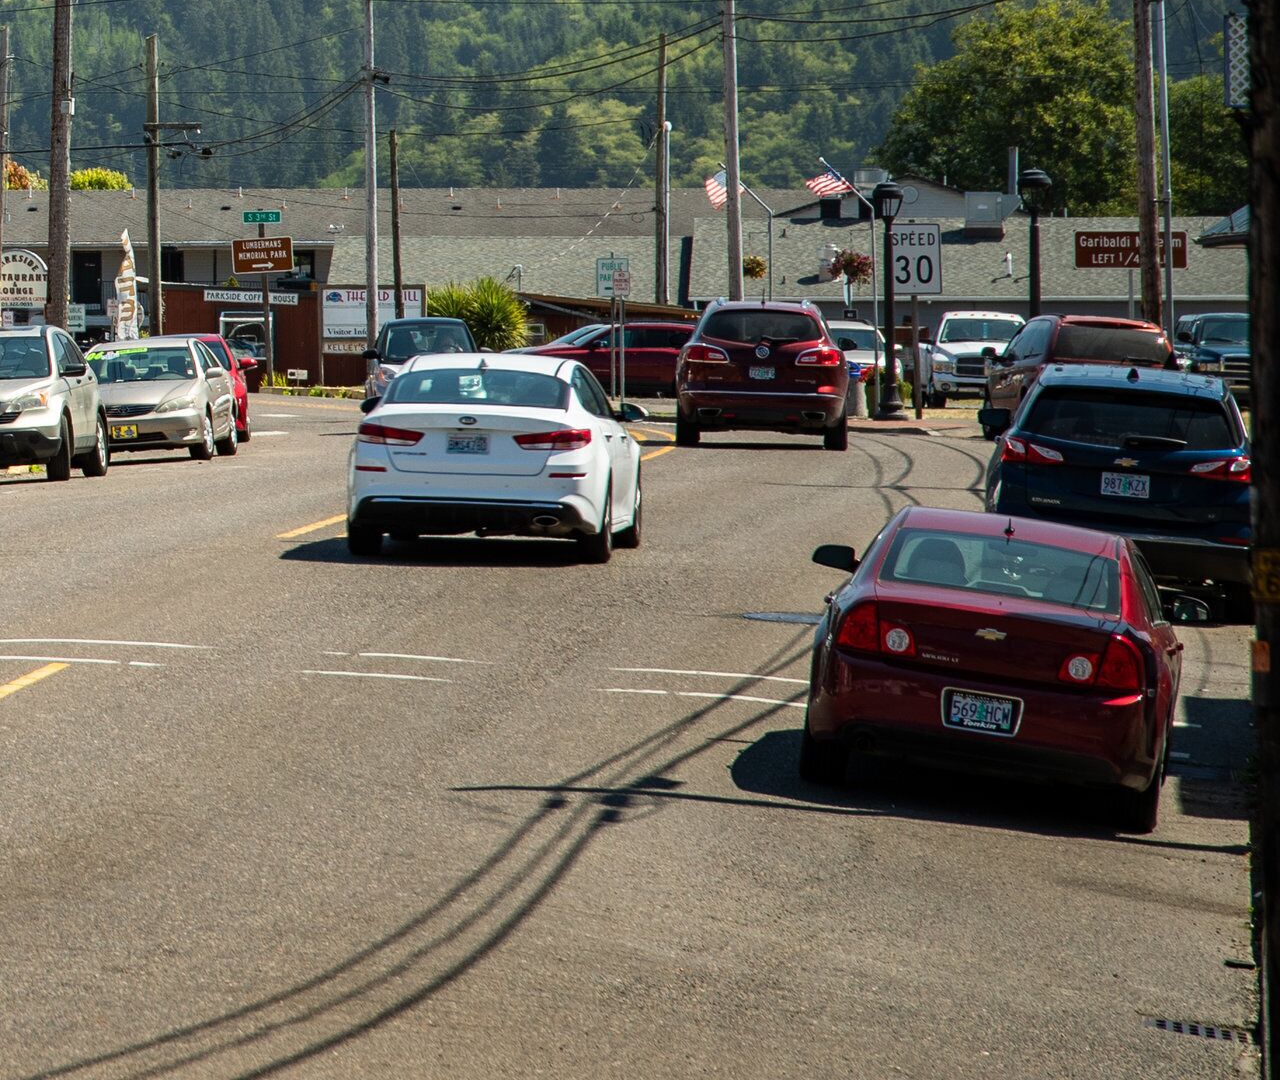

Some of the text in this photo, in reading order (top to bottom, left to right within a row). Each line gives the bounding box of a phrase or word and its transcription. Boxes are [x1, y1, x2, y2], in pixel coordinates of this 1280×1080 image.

[242, 240, 282, 249] LUMBERMANS
[892, 232, 935, 246] SPEED
[1080, 235, 1130, 248] Garibaldi
[238, 250, 287, 260] MEMORIAL PARK
[1092, 254, 1115, 264] LEFT
[2, 254, 40, 272] RKSIDE
[895, 255, 933, 284] 30
[1, 287, 34, 295] OUNGE
[206, 291, 296, 303] PARKSIDE COF HOUSE
[346, 290, 419, 302] THE LD ILL
[1103, 477, 1148, 492] 987 KZX
[952, 700, 978, 718] 569
[963, 718, 997, 730] Tonkin
